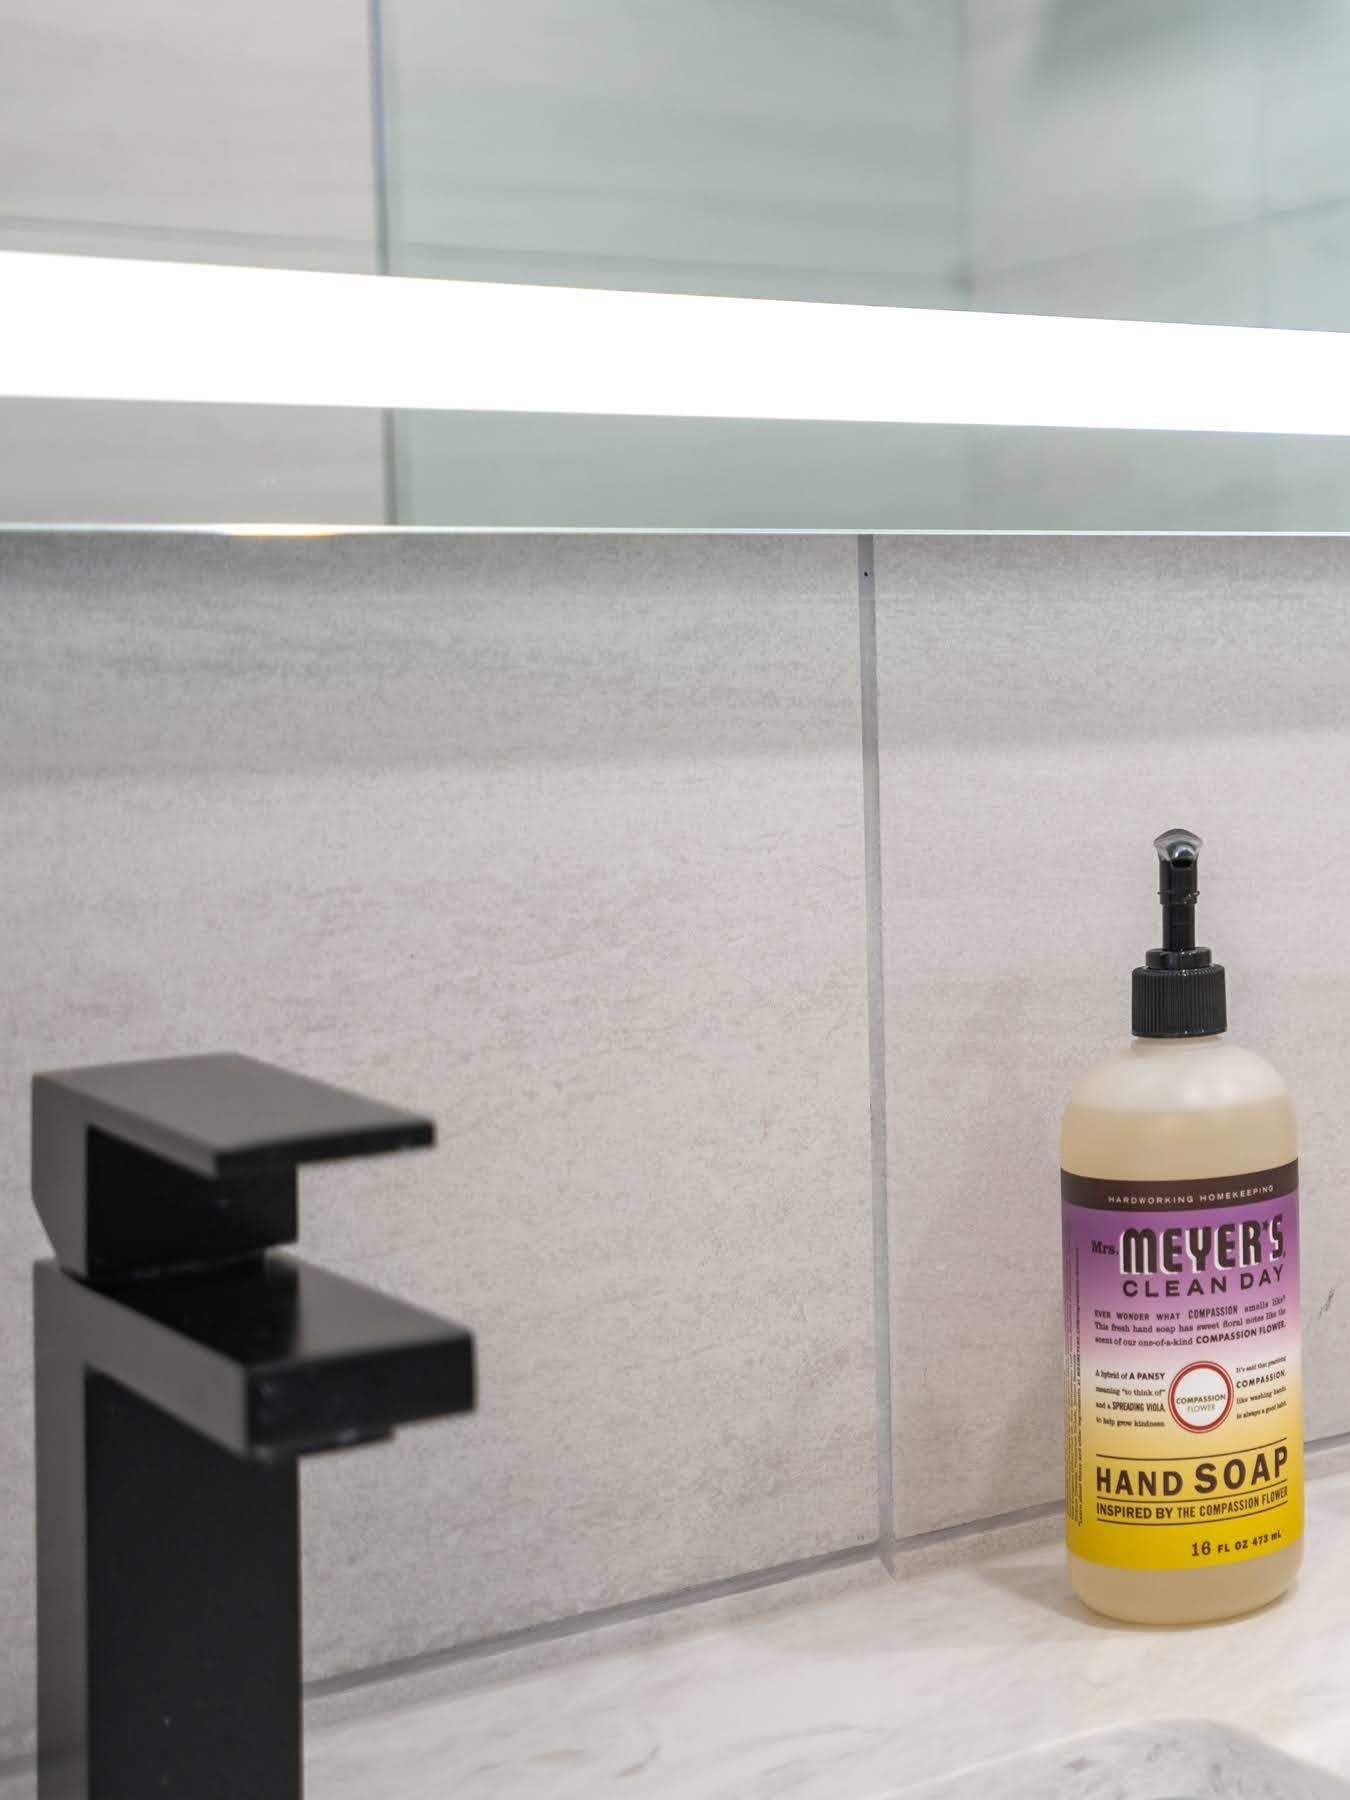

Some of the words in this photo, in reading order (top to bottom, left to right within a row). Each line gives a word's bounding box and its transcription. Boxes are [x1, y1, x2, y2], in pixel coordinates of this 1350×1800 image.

[1108, 1195, 1194, 1205] HARDWORKING
[1200, 1184, 1275, 1202] HOMEKEEPING
[1091, 1240, 1119, 1256] Mrs.
[1122, 1275, 1228, 1298] CLEAN
[1240, 1263, 1284, 1290] DAY
[1094, 1309, 1111, 1319] EVER
[1116, 1312, 1150, 1321] WONDER
[1156, 1312, 1181, 1321] WHAT
[1188, 1305, 1239, 1320] COMPASSION
[1244, 1300, 1269, 1313] smells
[1094, 1321, 1109, 1332] This
[1111, 1322, 1130, 1333] fresh
[1132, 1323, 1153, 1333] hand
[1156, 1326, 1176, 1335] soap
[1178, 1323, 1194, 1333] has
[1196, 1321, 1220, 1332] sweet
[1222, 1317, 1243, 1329] floral
[1245, 1315, 1264, 1325] notes
[1265, 1311, 1277, 1321] like
[1094, 1335, 1113, 1345] scent
[1114, 1336, 1122, 1346] of
[1122, 1338, 1137, 1346] our
[1138, 1336, 1193, 1347] one-of-a-kind
[1195, 1325, 1257, 1345] COMPASSION
[1120, 1372, 1128, 1380] of
[1129, 1372, 1136, 1380] A
[1136, 1372, 1166, 1381] PANSY
[1133, 1388, 1154, 1397] think
[1175, 1393, 1227, 1405] COMPASSION
[1236, 1396, 1249, 1405] like
[1249, 1391, 1273, 1402] washing
[1112, 1401, 1145, 1412] SPREADING
[1187, 1403, 1216, 1413] FLOWER
[1096, 1466, 1184, 1497] HAND
[1194, 1445, 1288, 1495] SOAP
[1096, 1502, 1153, 1520] INSPIRED
[1155, 1507, 1174, 1520] BY
[1177, 1506, 1196, 1519] THE
[1199, 1497, 1260, 1517] COMPASSION
[1261, 1485, 1288, 1506] FLOWER
[1191, 1540, 1212, 1557] 16
[1217, 1544, 1231, 1554] FL
[1235, 1539, 1249, 1551] OZ
[1252, 1533, 1269, 1547] 473
